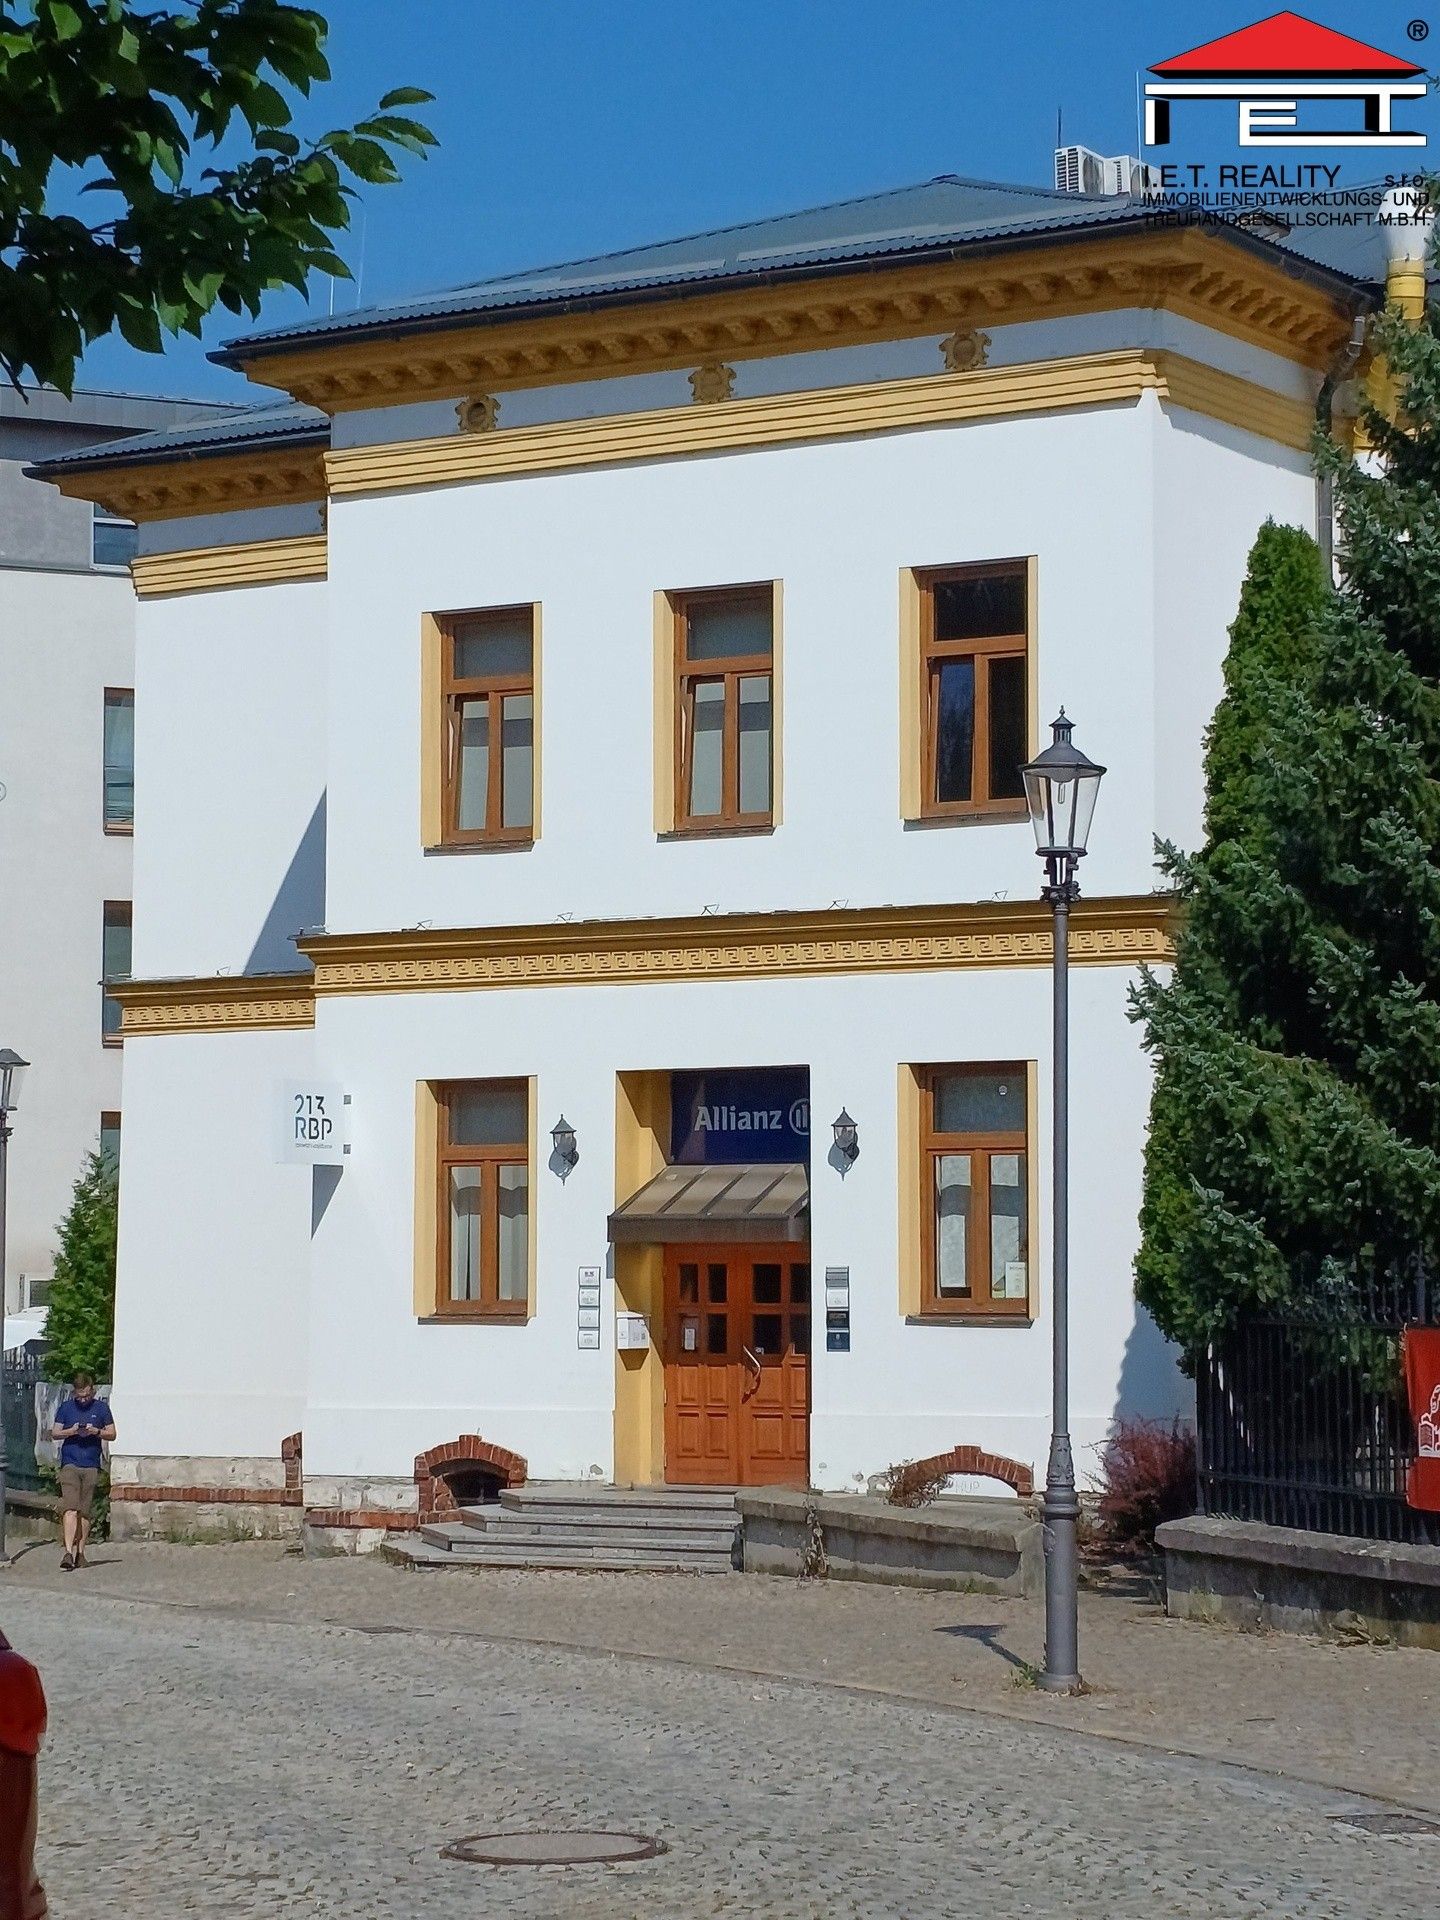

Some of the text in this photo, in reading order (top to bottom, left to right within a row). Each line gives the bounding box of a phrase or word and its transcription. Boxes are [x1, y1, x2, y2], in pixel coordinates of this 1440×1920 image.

[294, 1093, 325, 1115] 213
[295, 1116, 332, 1140] RBP
[694, 1105, 782, 1131] Allianz
